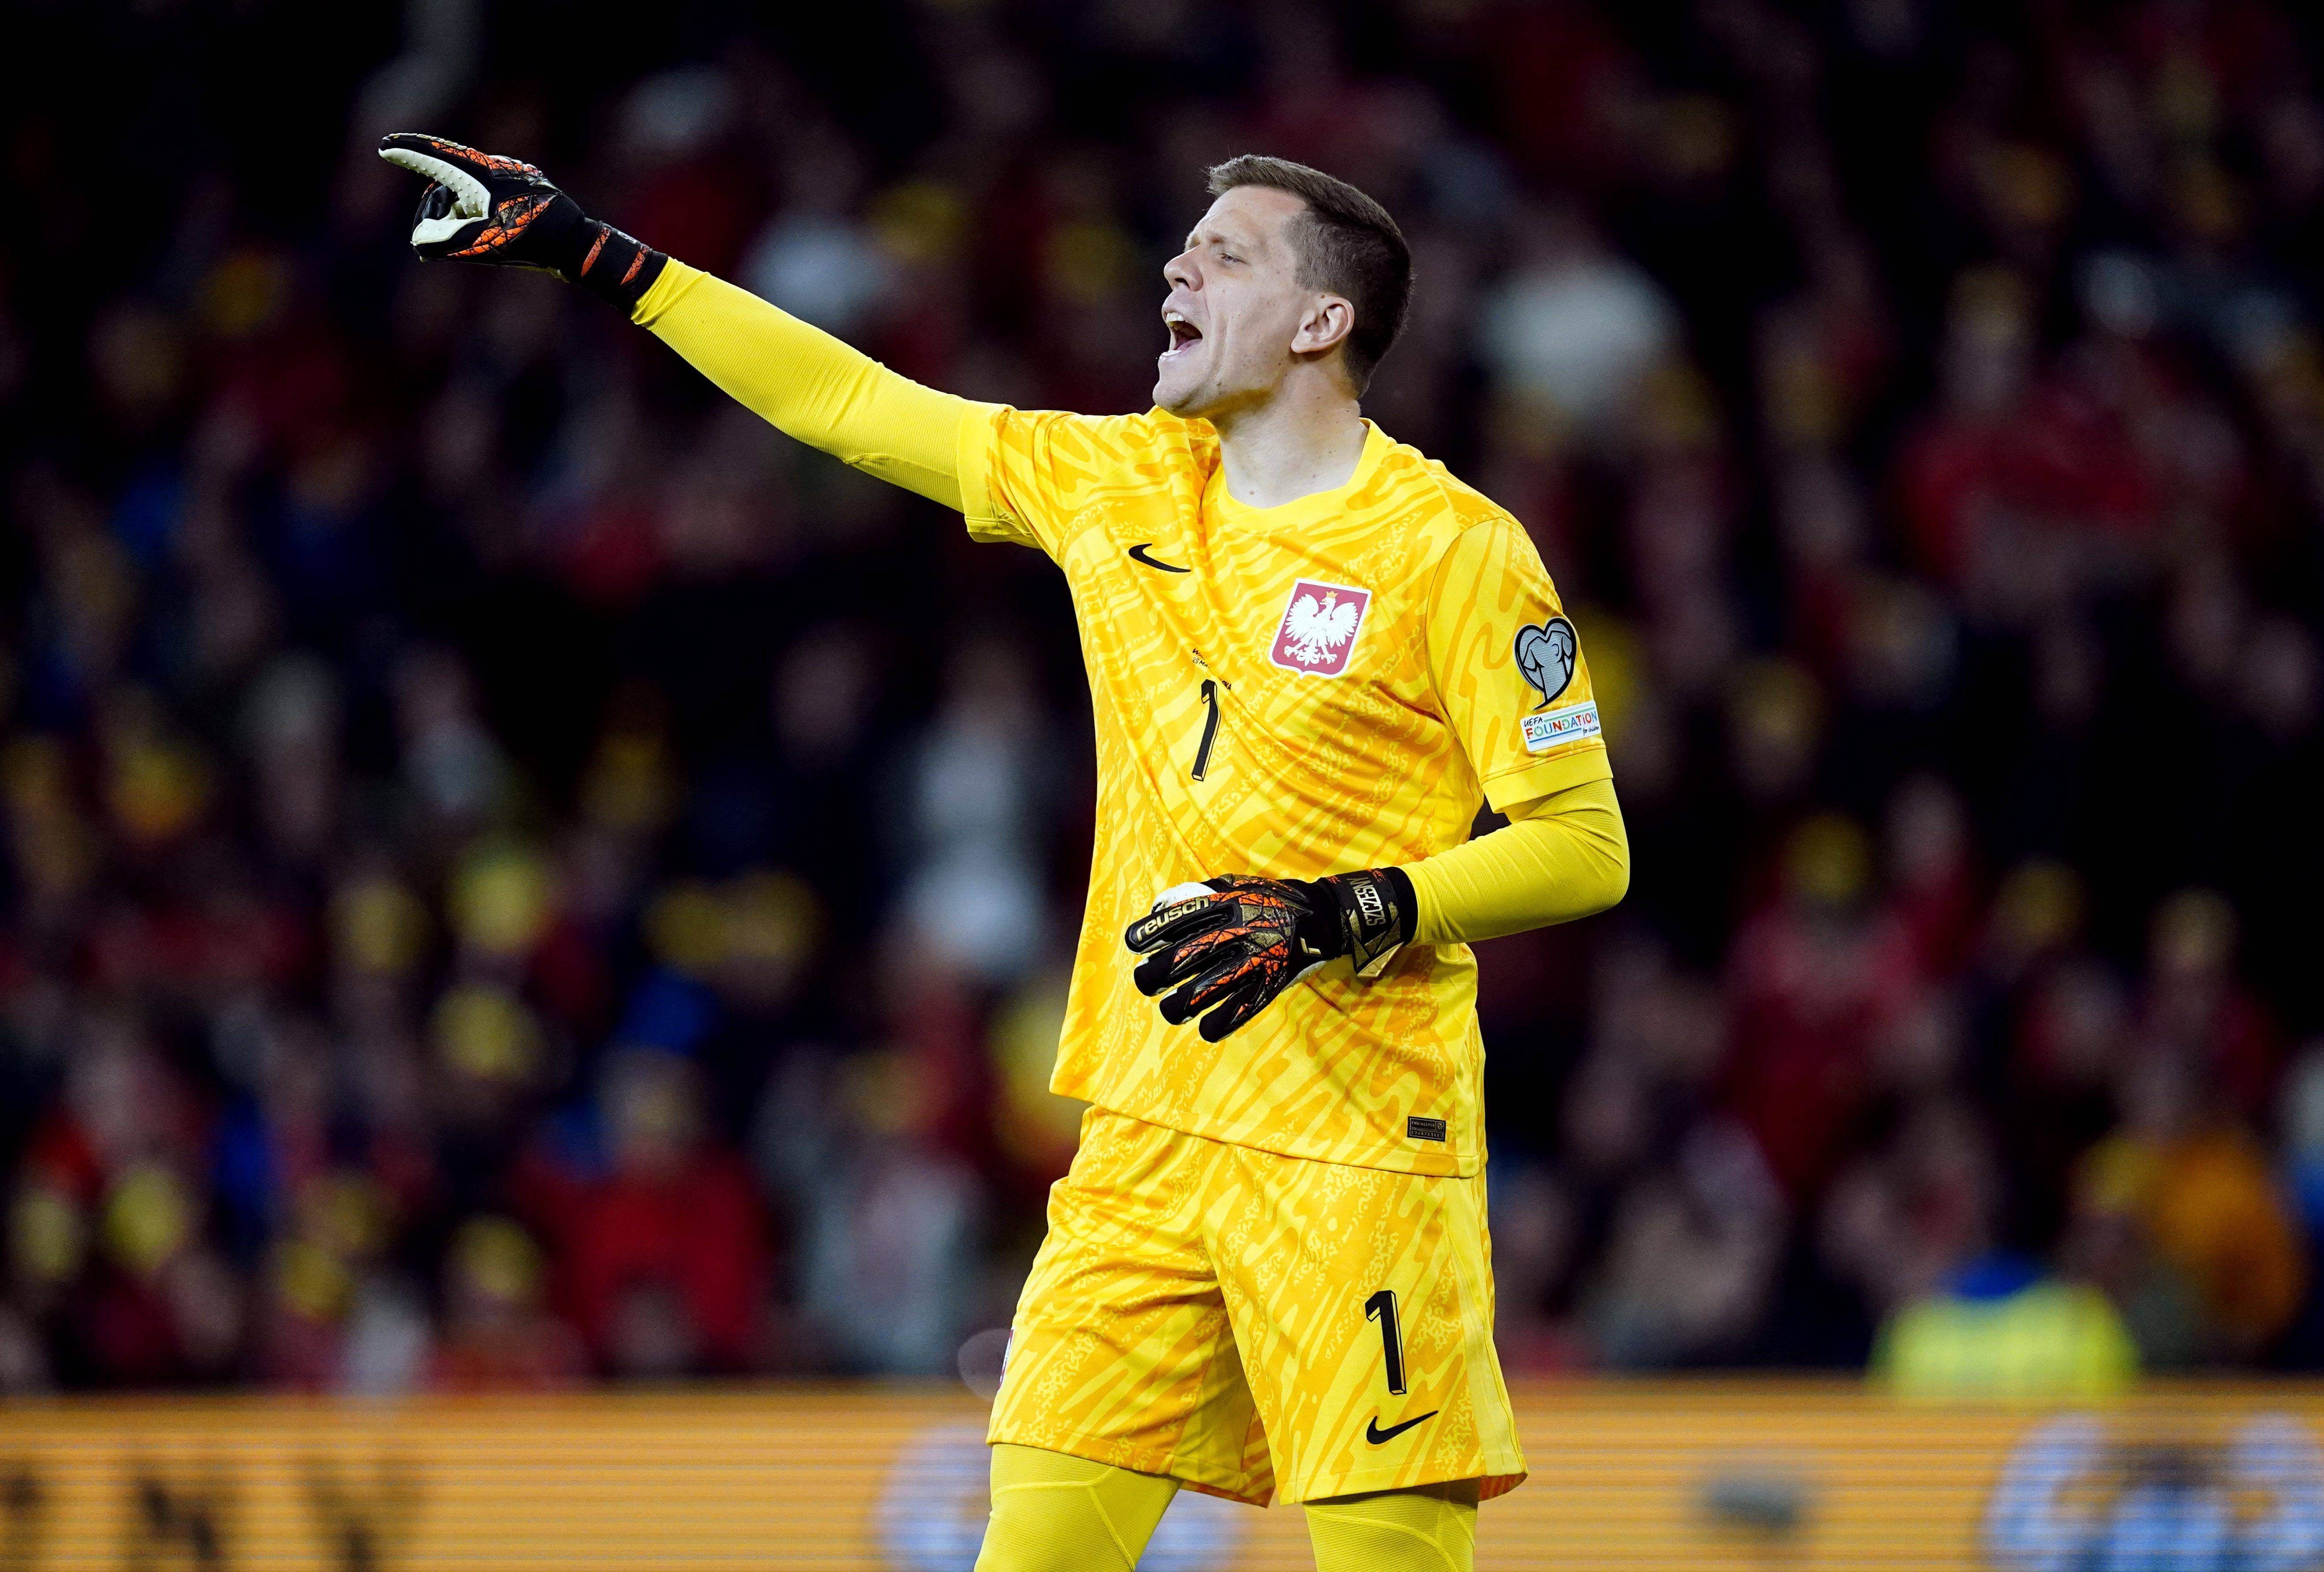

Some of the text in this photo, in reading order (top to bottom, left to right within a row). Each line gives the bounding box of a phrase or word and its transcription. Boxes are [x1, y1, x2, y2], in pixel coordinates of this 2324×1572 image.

[1192, 679, 1221, 782] 1
[1524, 717, 1543, 727] UEFA
[1136, 897, 1209, 942] reusch
[1346, 877, 1386, 926] SZCZESNY
[1365, 1290, 1407, 1395] 1
